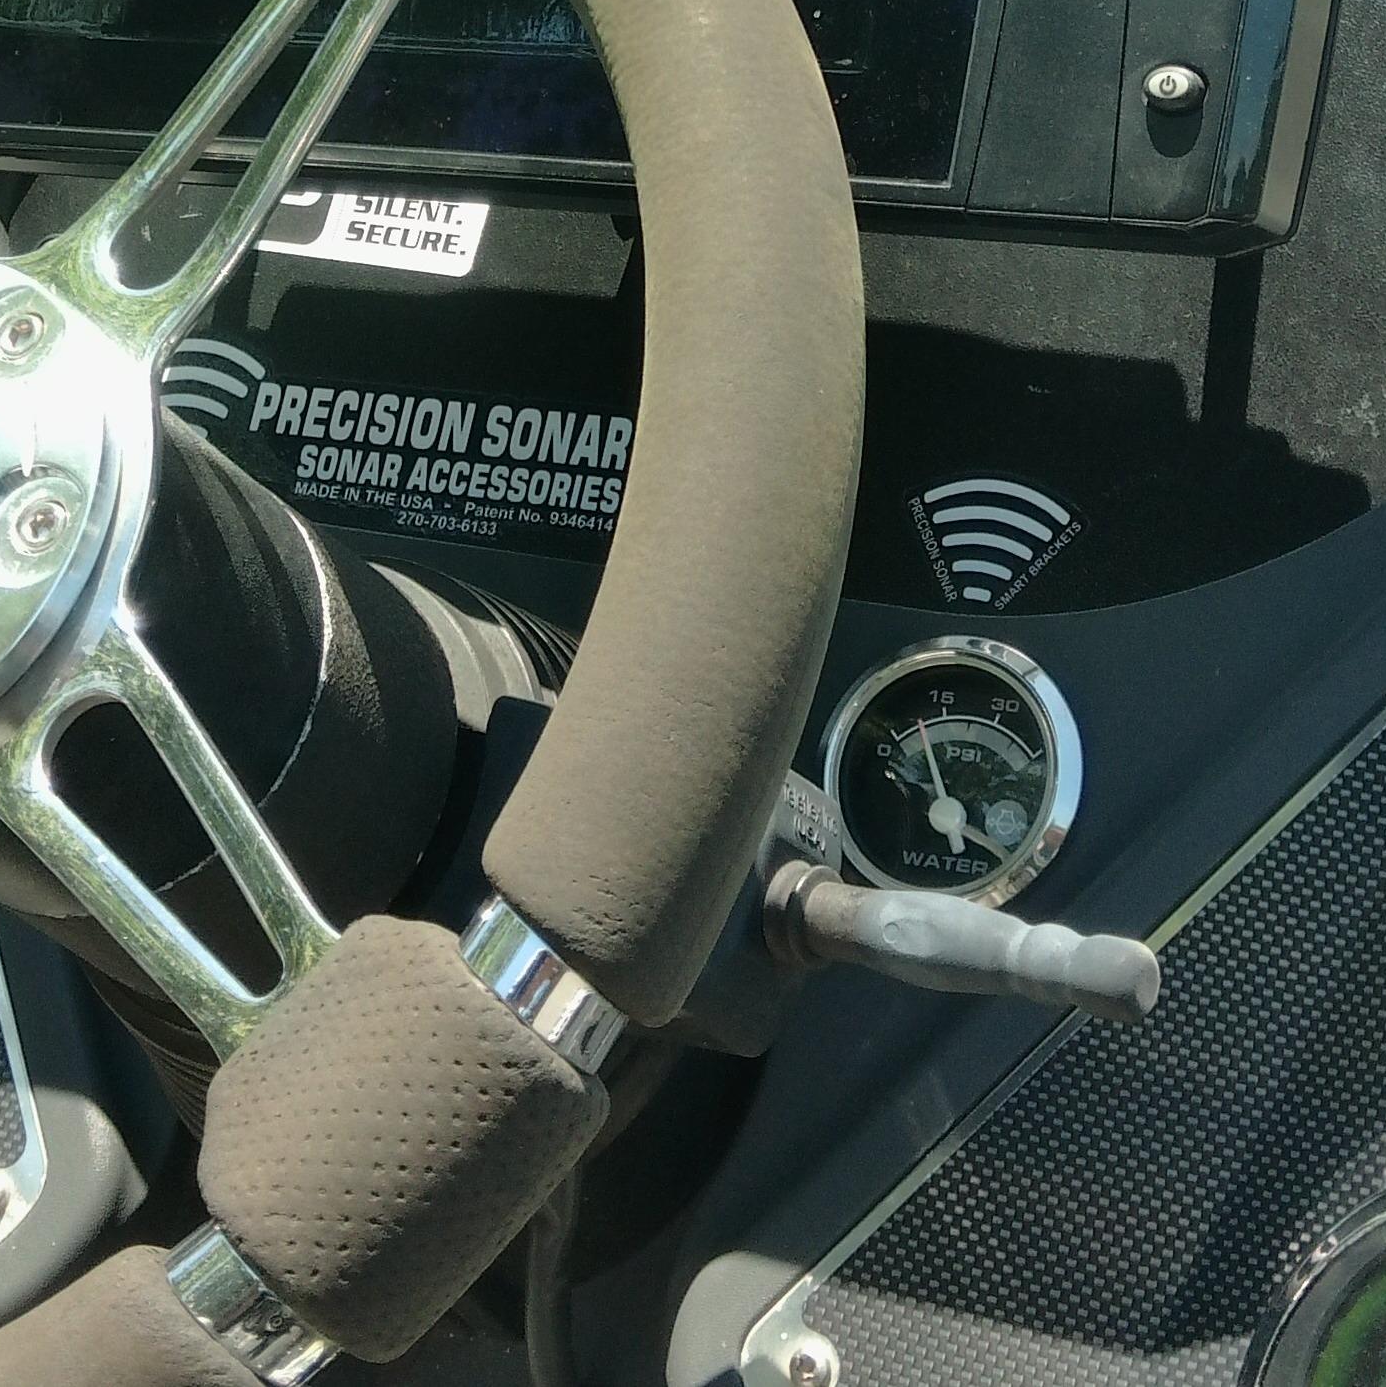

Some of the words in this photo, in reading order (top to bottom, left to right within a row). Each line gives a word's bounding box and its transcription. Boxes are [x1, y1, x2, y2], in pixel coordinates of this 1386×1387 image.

[353, 196, 464, 225] SILENT.
[345, 220, 466, 255] SECURE.
[249, 381, 476, 454] PRECISION
[481, 404, 634, 471] SONAR
[296, 444, 403, 489] SONAR
[405, 456, 623, 514] ACCESSORIES
[294, 481, 341, 499] MADE
[344, 487, 363, 502] IN
[365, 489, 397, 507] THE
[400, 493, 434, 510] USA
[464, 502, 514, 520] Patent
[518, 508, 544, 523] No.
[549, 512, 614, 533] 9346414
[396, 511, 498, 536] 270-703-6133
[908, 496, 941, 560] PRECISION
[933, 559, 958, 602] SONAR
[993, 573, 1030, 611] SMART
[1028, 521, 1083, 577] BRACKETS
[929, 689, 955, 705] 15
[991, 697, 1020, 713] 30
[877, 743, 892, 758] 0
[946, 745, 982, 764] PSI
[902, 850, 989, 875] WATER
